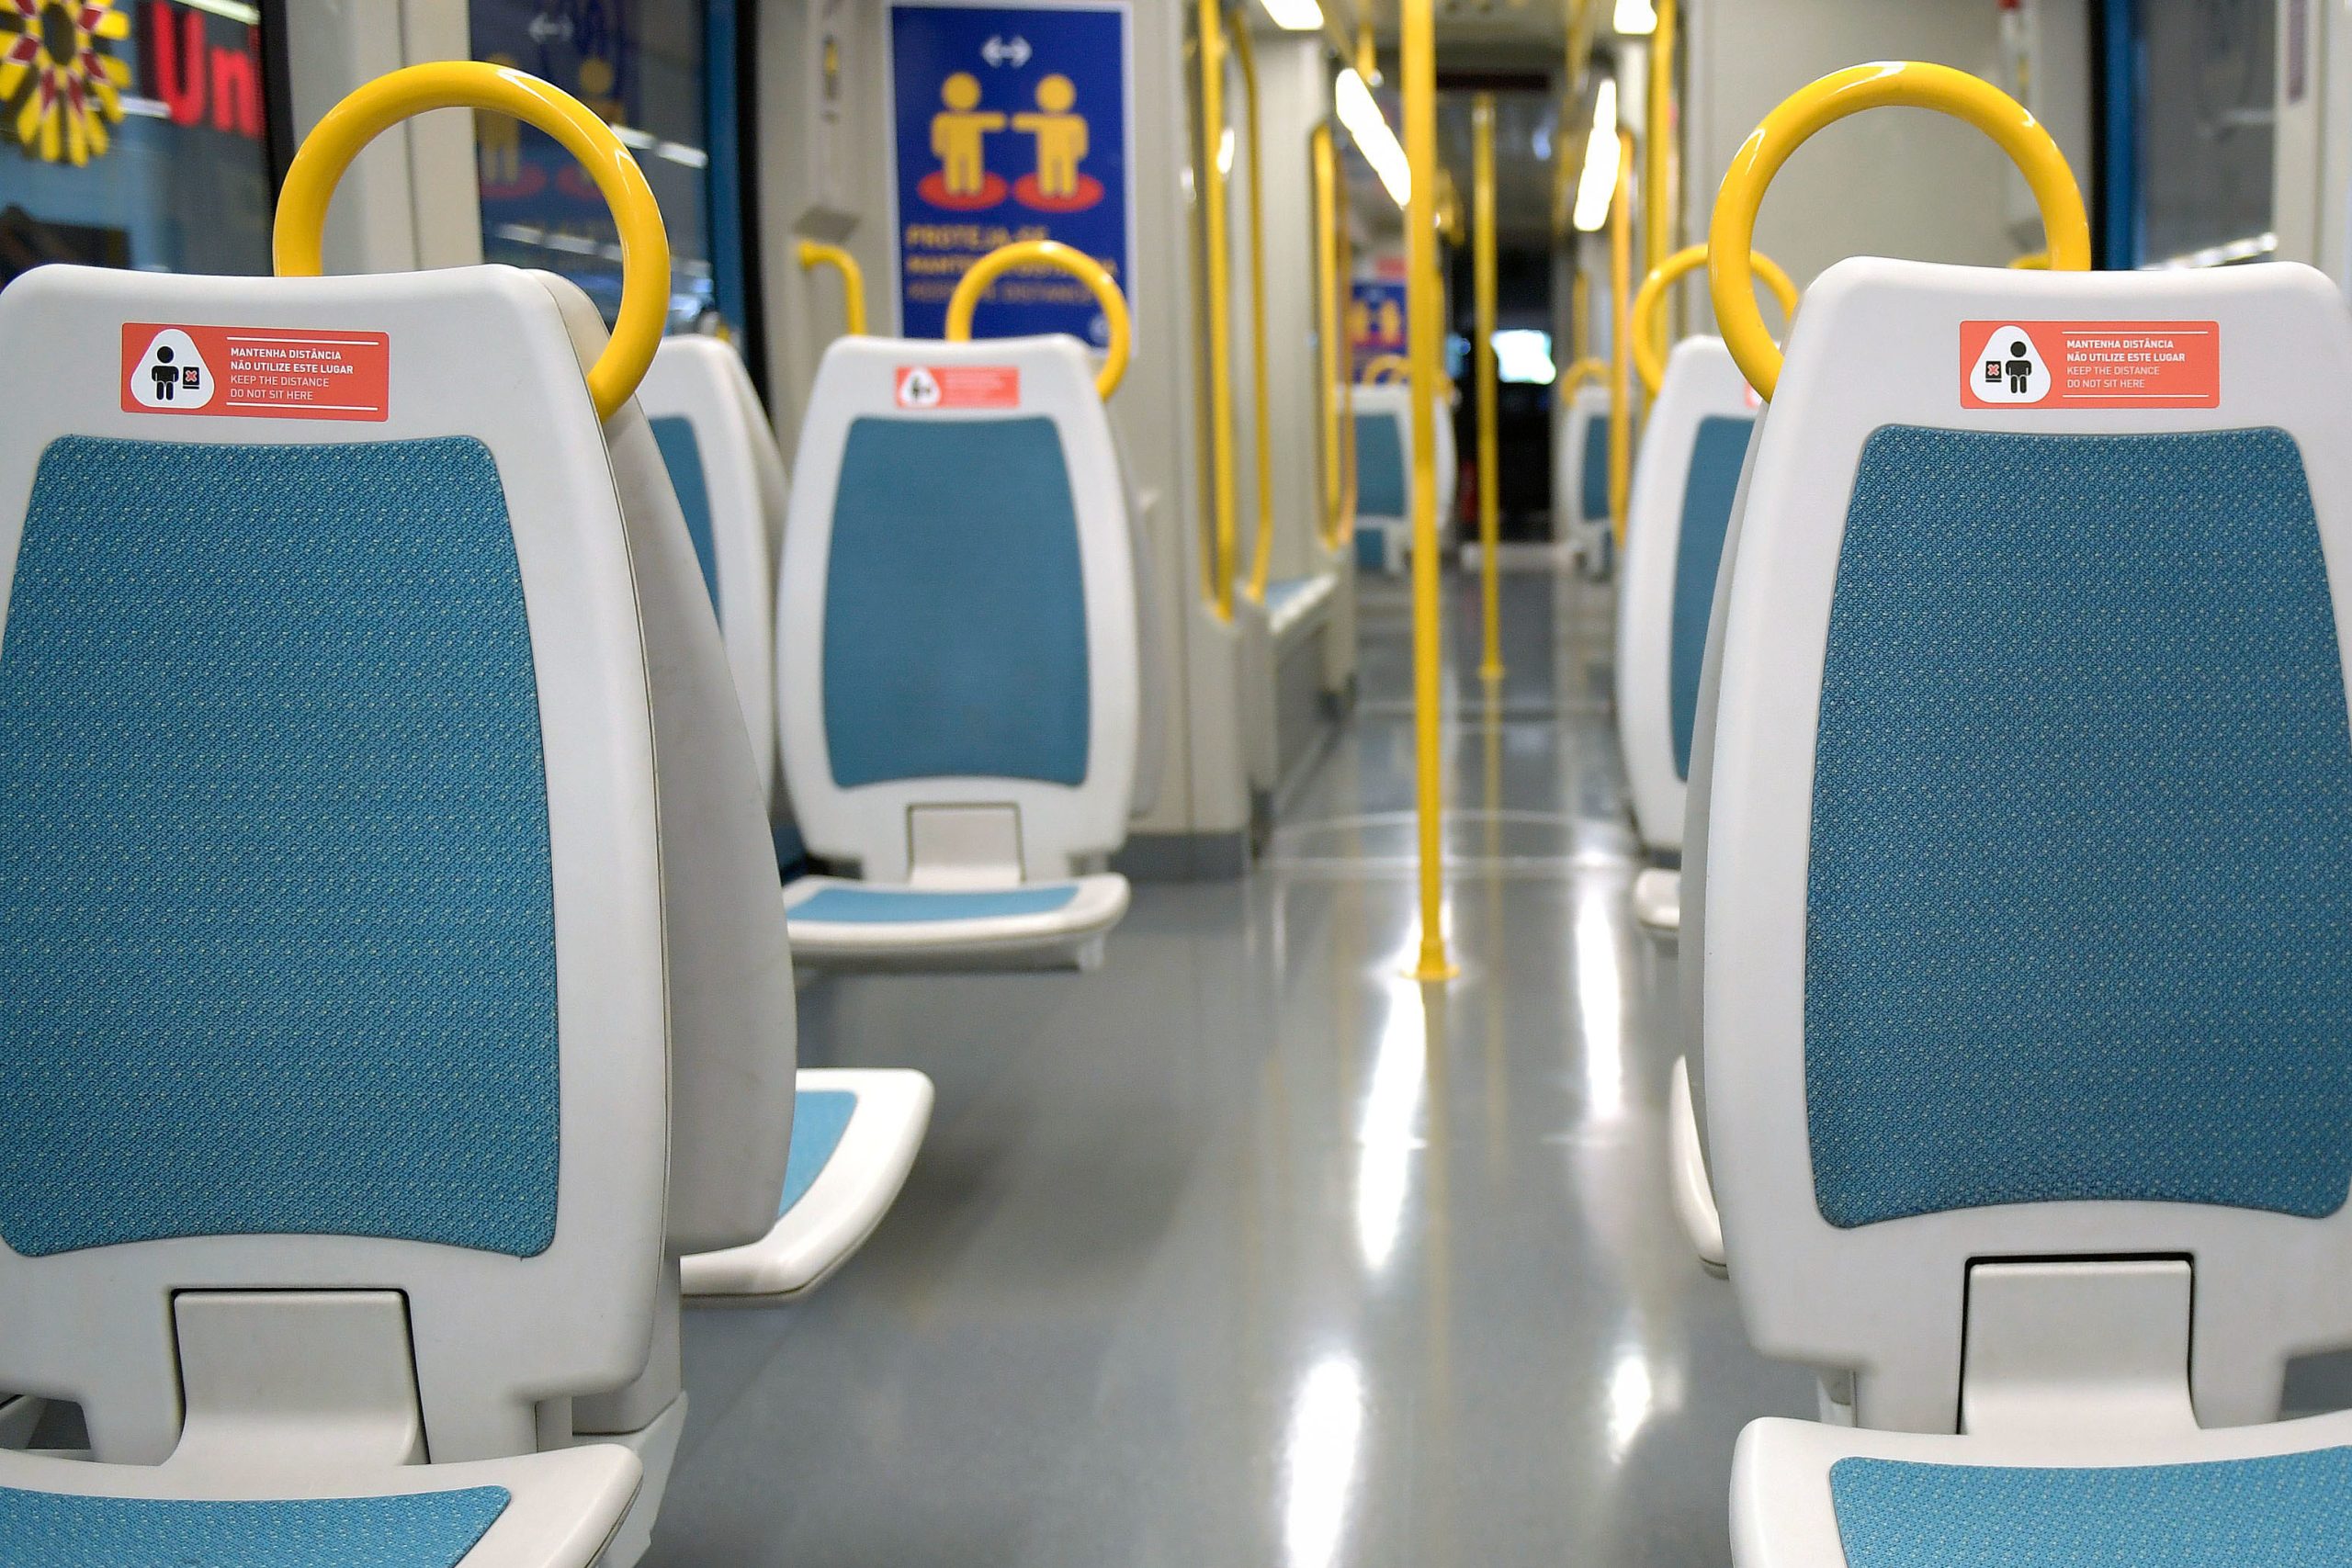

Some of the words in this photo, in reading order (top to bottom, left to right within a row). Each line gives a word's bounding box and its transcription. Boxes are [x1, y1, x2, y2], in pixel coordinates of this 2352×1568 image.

[152, 0, 264, 139] Un
[2066, 340, 2121, 348] MANTENHA
[2123, 338, 2174, 349] DISTÂNCIA
[231, 348, 287, 358] MANTENHA
[289, 348, 341, 359] DISTÂNCIA
[2066, 351, 2087, 362] NÃO
[2089, 353, 2125, 362] UTILIZE
[2128, 353, 2151, 362] ESTE
[2154, 353, 2186, 362] LUGAR
[231, 360, 252, 370] NÃO
[254, 362, 290, 372] UTILIZE
[293, 363, 318, 373] ESTE
[321, 365, 354, 374] LUGAR
[2066, 366, 2092, 375] KEEP
[2094, 366, 2111, 375] THE
[2114, 366, 2160, 375] DISTANCE
[231, 375, 256, 384] KEEP
[259, 376, 278, 385] THE
[280, 377, 330, 387] DISTANCE
[2067, 379, 2080, 388] DO
[2082, 379, 2101, 388] NOT
[2103, 379, 2118, 388] SIT
[2120, 379, 2144, 388] HERE
[231, 389, 244, 398] DO
[246, 389, 266, 399] NOT
[269, 389, 284, 399] SIT
[287, 390, 313, 400] HERE
